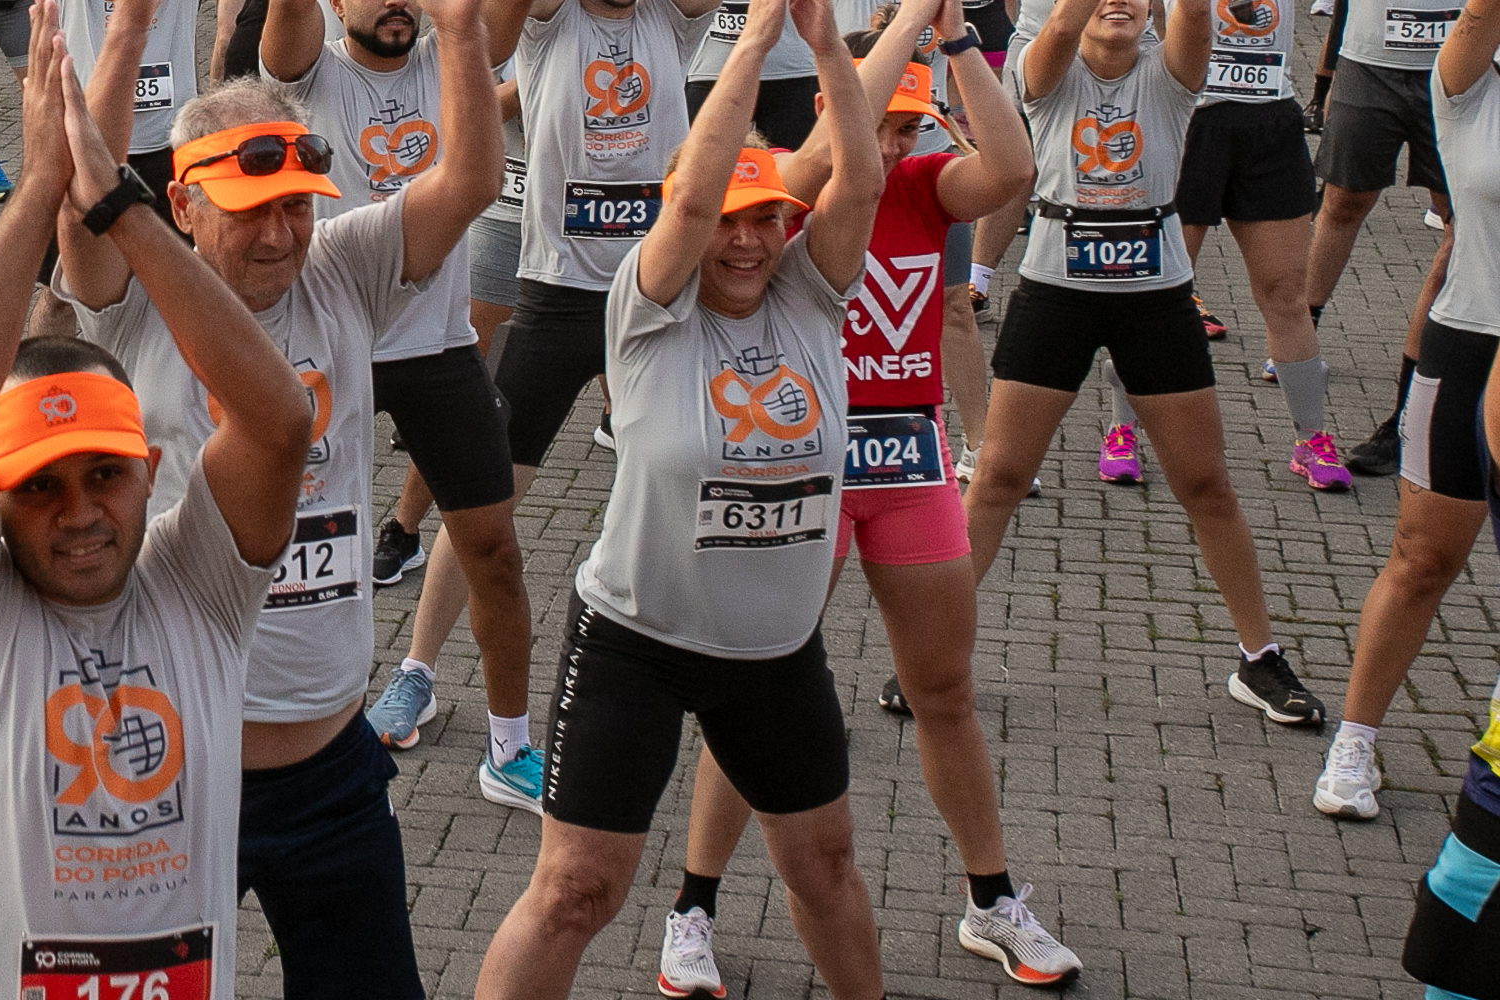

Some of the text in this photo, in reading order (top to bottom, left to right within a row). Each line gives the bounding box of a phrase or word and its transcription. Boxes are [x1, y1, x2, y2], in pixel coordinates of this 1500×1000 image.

[1401, 22, 1446, 39] 5211
[1218, 63, 1268, 85] 7066
[584, 60, 650, 117] 90
[590, 112, 647, 127] ANOS
[584, 131, 643, 140] CORRIDA
[607, 137, 650, 150] PORTO
[1071, 117, 1143, 174] 90
[360, 120, 438, 182] 90
[1082, 169, 1138, 183] ANOS
[584, 200, 647, 224] 1023
[1084, 241, 1148, 265] 1022
[39, 393, 77, 422] 90
[710, 365, 820, 443] 90
[731, 440, 816, 457] ANOS
[846, 436, 921, 468] 1024
[722, 464, 809, 477] CORRIDA
[722, 499, 803, 530] 6311
[273, 542, 334, 583] 12
[45, 684, 185, 806] 90
[65, 801, 174, 828] ANOS
[55, 838, 171, 863] CORRIDA
[54, 855, 188, 883] DO PORTO
[35, 951, 56, 968] 90
[77, 971, 171, 1000] 176
